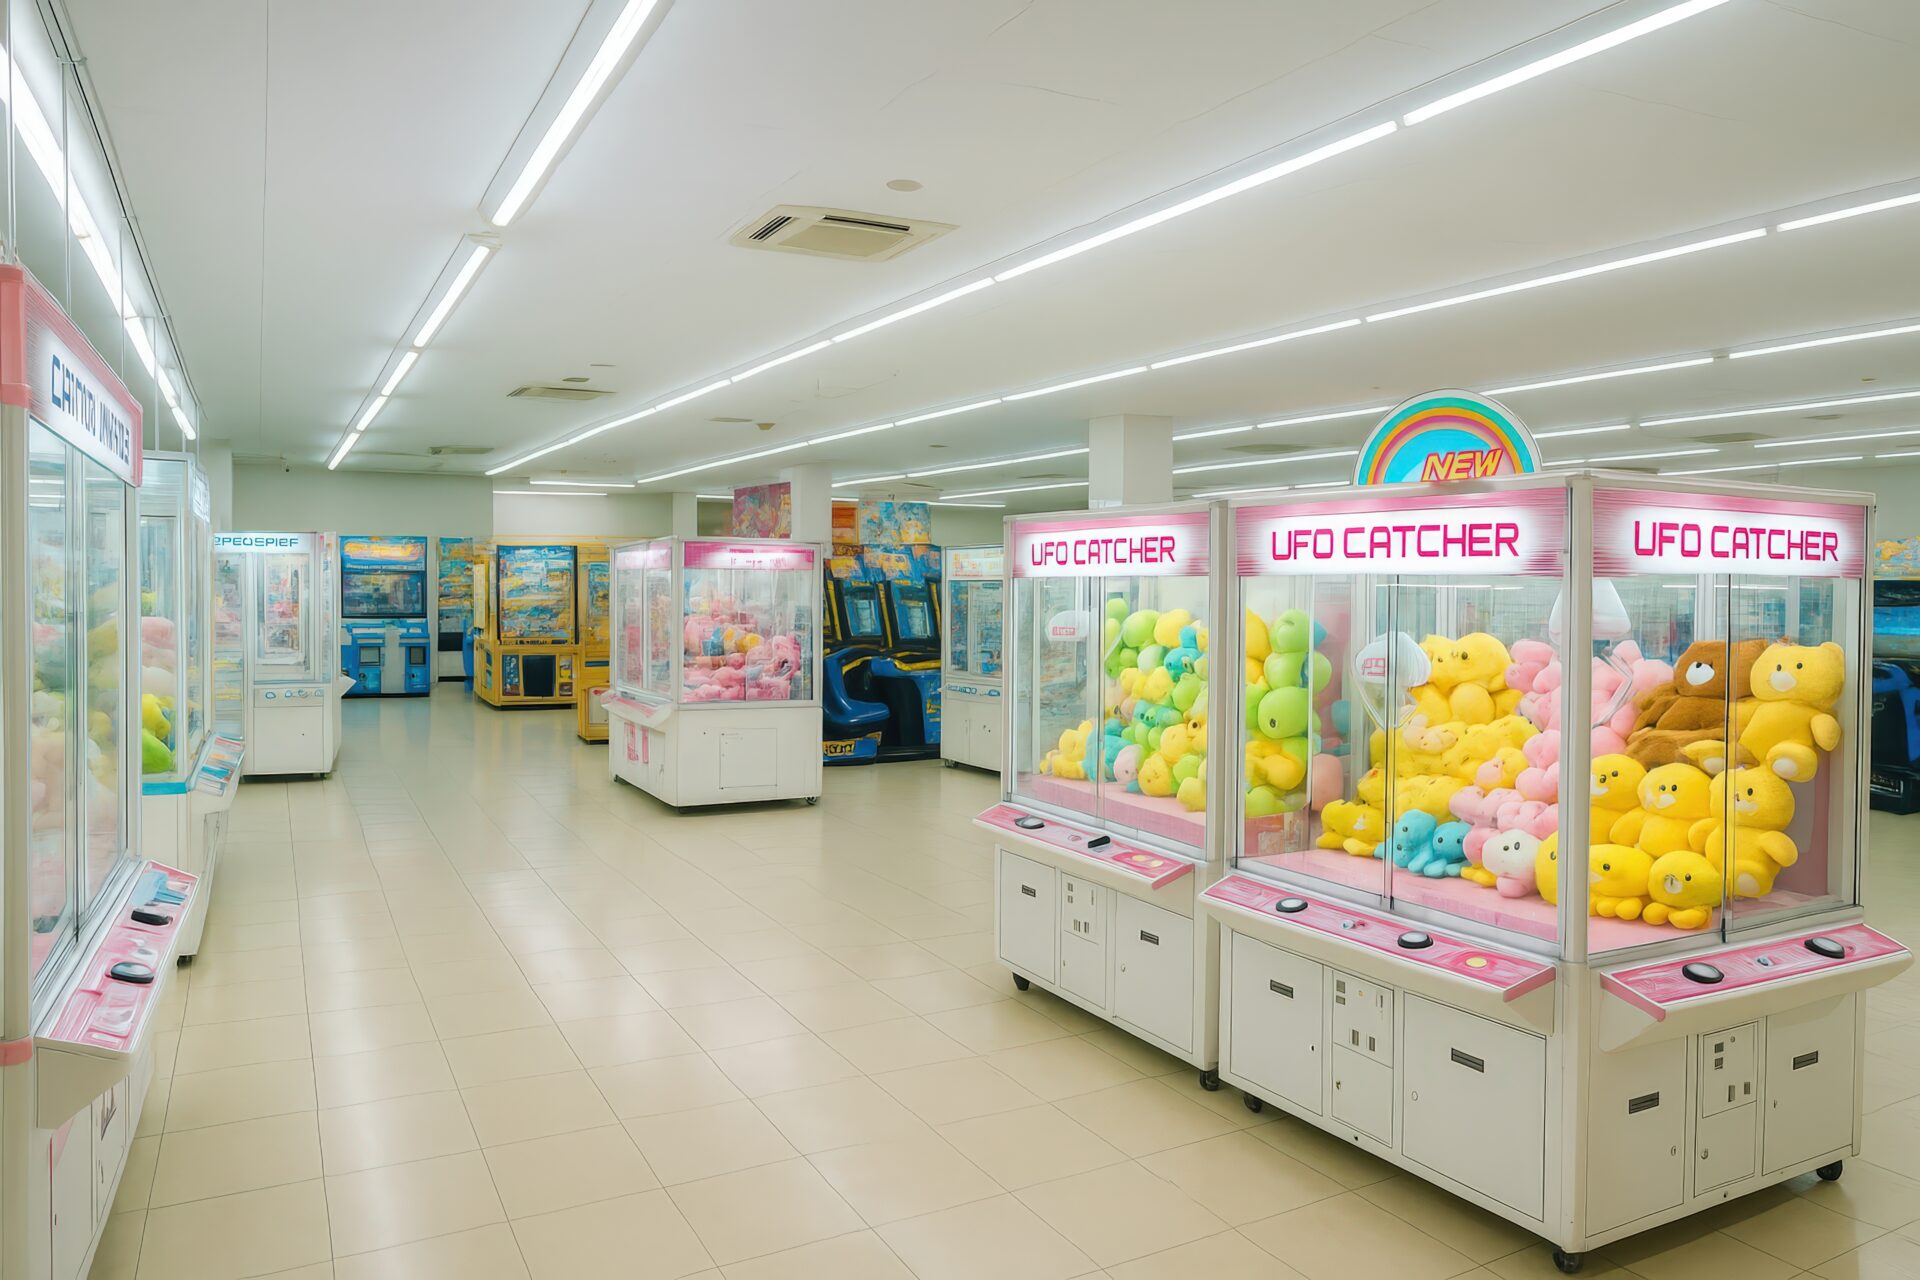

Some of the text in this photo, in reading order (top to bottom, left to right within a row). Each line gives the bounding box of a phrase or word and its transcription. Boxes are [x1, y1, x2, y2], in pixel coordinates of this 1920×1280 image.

[1421, 448, 1503, 482] NEW
[1031, 536, 1176, 566] UFO CATCHER
[1271, 522, 1520, 560] UFO CATCHER
[1634, 520, 1839, 561] UFO CATCHER
